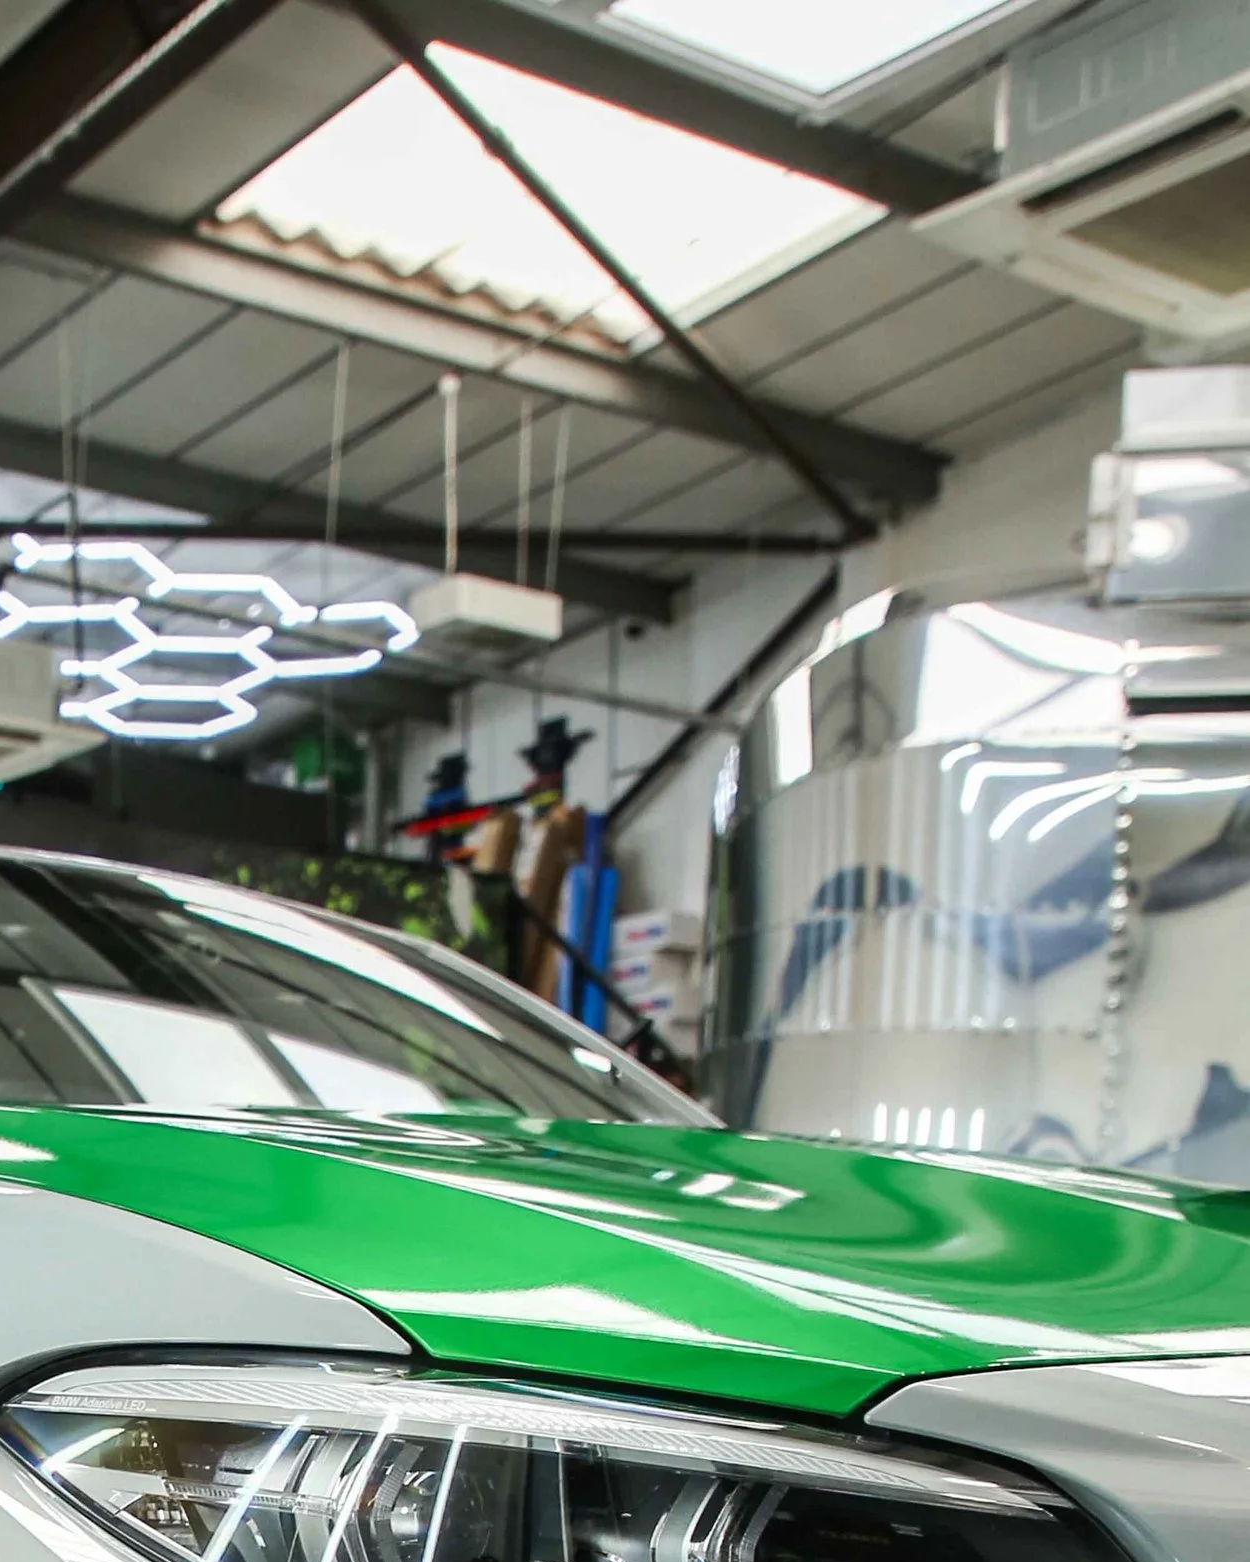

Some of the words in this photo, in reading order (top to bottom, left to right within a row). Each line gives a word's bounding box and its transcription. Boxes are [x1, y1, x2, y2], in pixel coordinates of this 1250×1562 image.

[52, 1396, 80, 1407] BMW
[81, 1398, 121, 1410] Adaptive
[123, 1400, 146, 1410] LED
